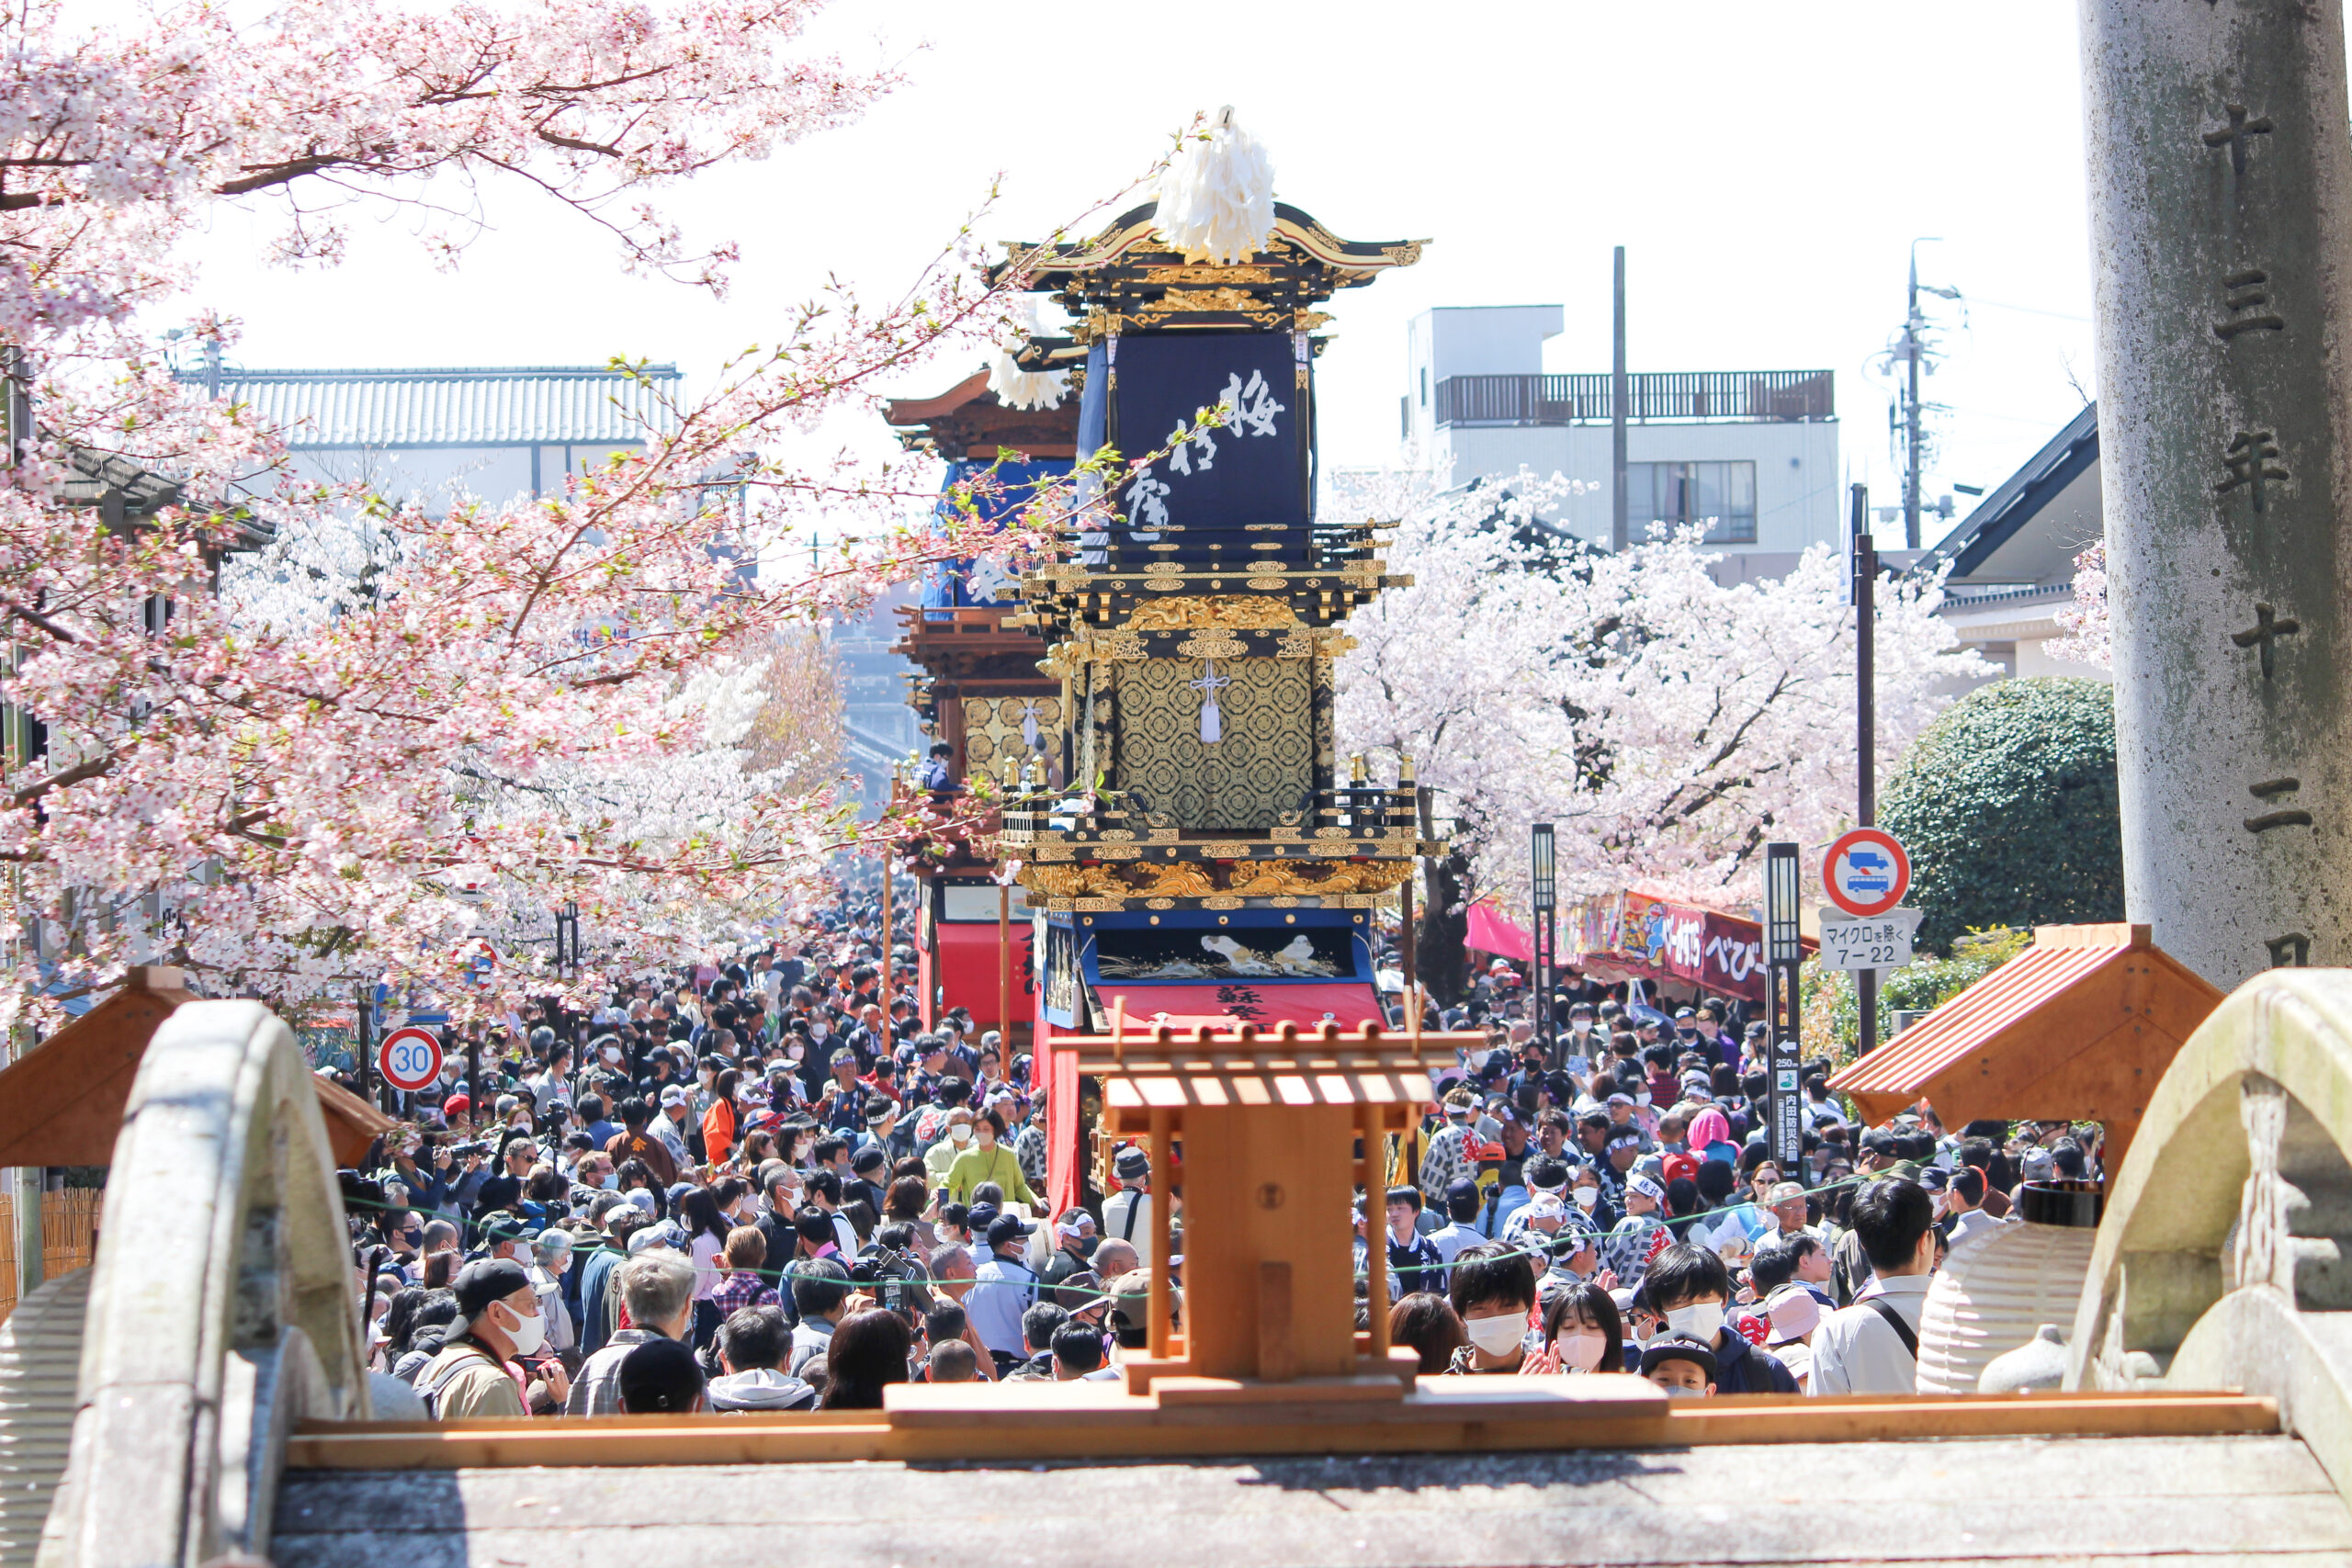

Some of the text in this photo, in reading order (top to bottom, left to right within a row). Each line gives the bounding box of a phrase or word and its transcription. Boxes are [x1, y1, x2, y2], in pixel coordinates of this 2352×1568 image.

[1826, 924, 1904, 945] マイクロを除く
[395, 1045, 428, 1073] 30
[1785, 1094, 1798, 1162] 内田防災公園
